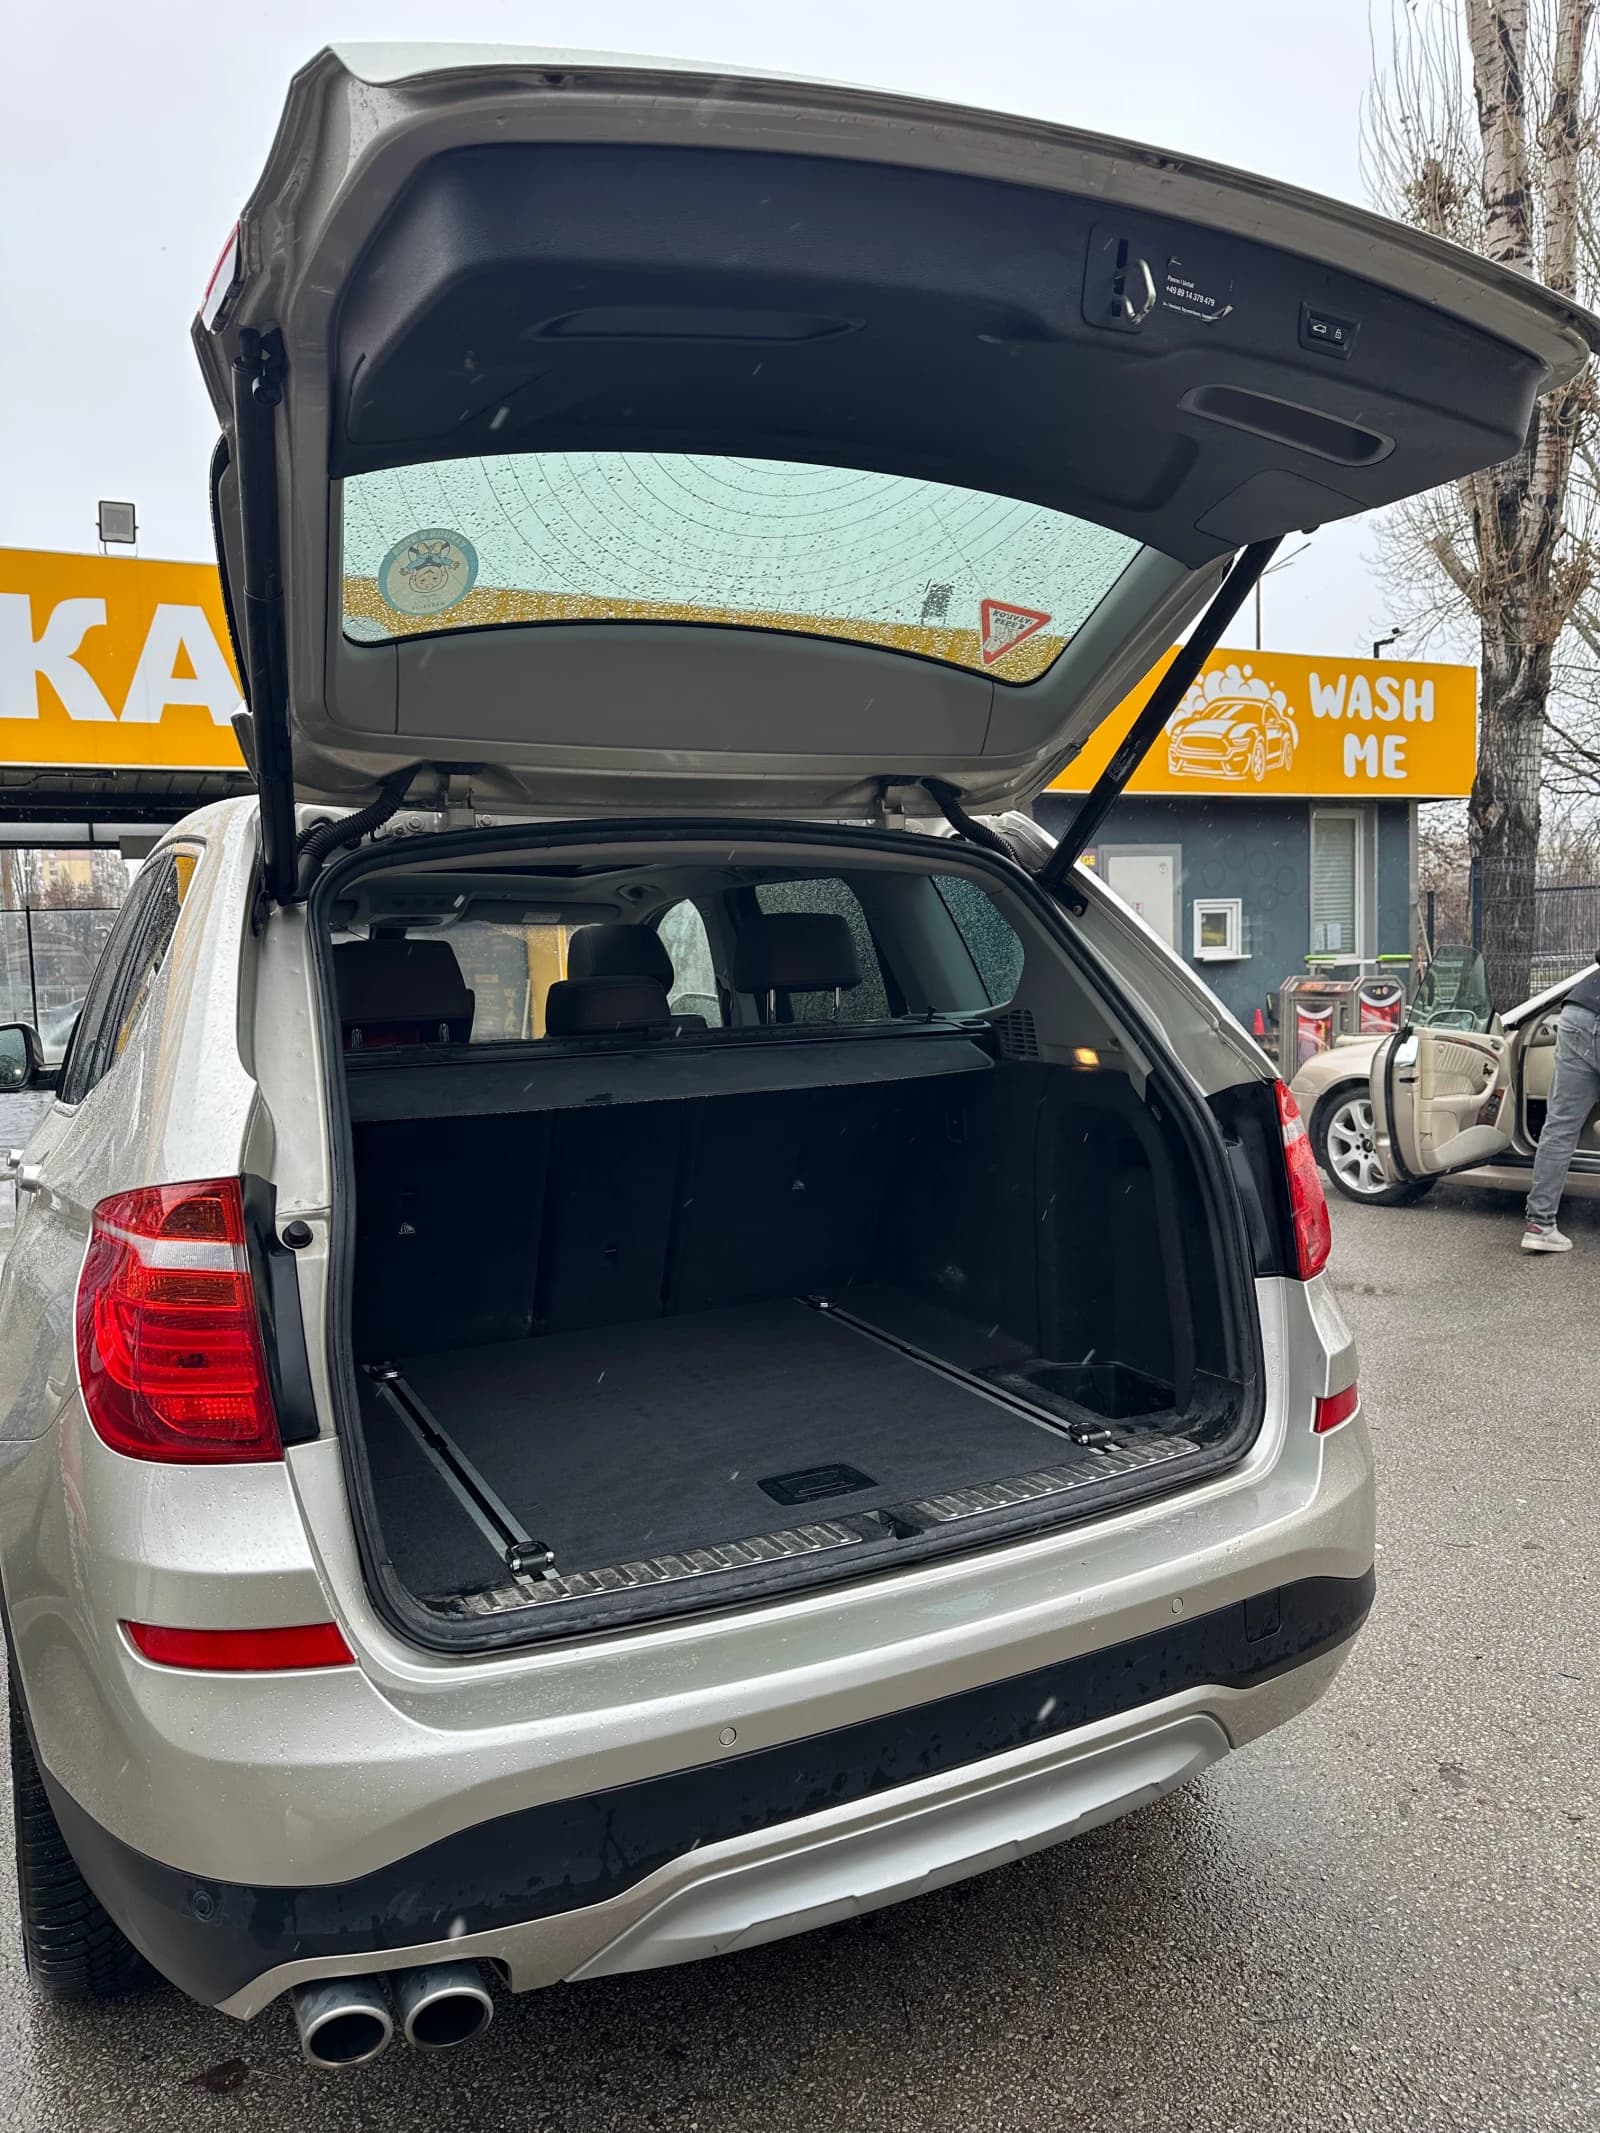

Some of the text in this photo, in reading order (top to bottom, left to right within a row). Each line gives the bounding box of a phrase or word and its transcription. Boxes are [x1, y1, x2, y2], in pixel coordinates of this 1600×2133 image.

[1166, 285, 1177, 295] +49
[1186, 291, 1193, 300] 14
[1193, 293, 1204, 303] 379
[1204, 297, 1215, 307] 479
[1308, 672, 1435, 723] WASH
[1343, 732, 1408, 780] ME
